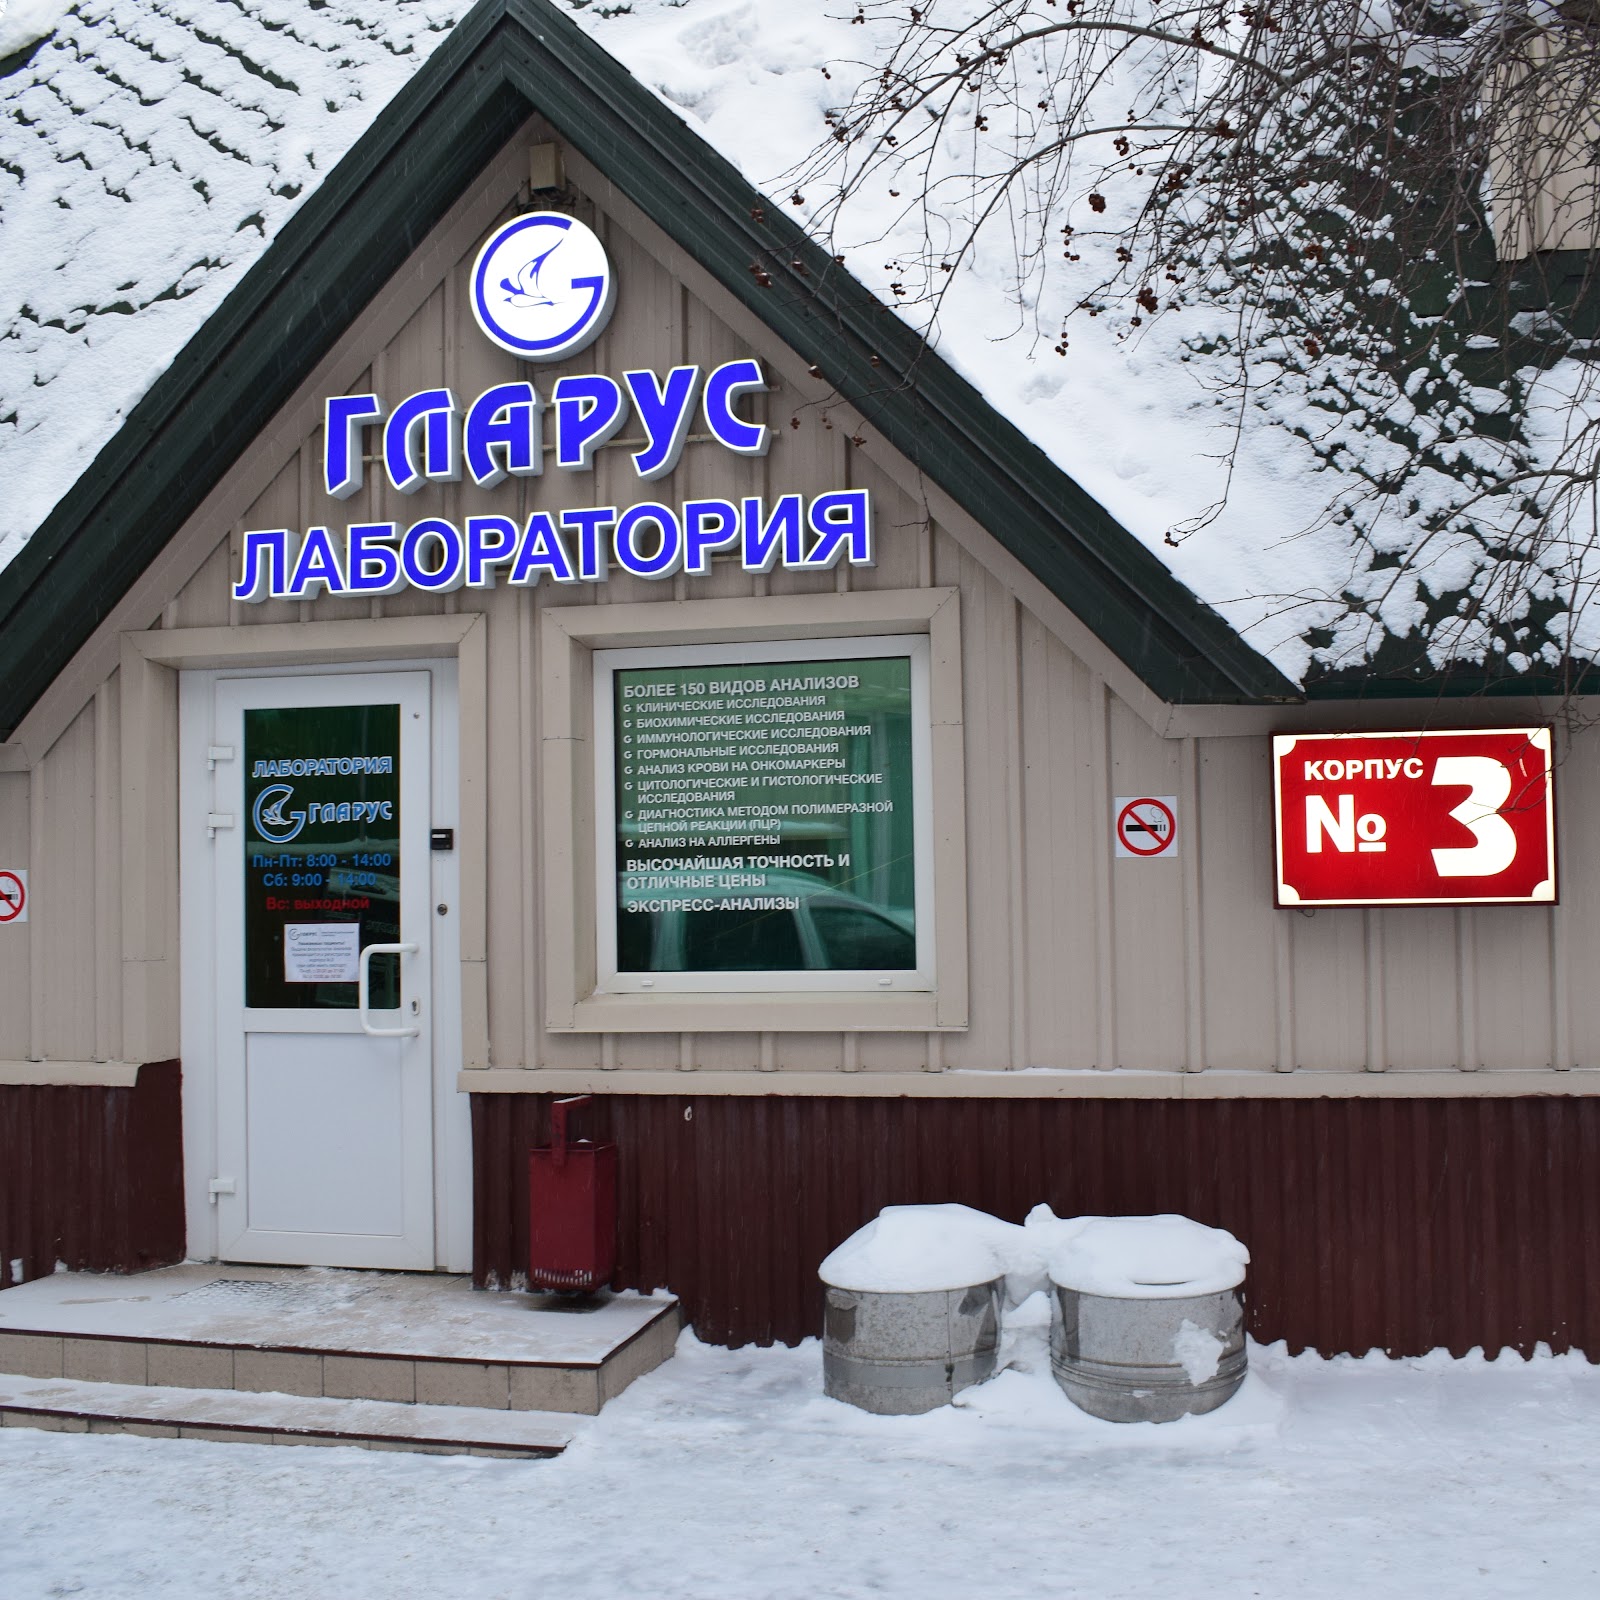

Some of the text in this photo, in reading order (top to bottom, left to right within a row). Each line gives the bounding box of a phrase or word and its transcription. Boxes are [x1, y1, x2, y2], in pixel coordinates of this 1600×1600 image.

[324, 358, 769, 497] ГЛАРУС
[232, 488, 870, 600] ЛАБОРАТОРИЯ
[624, 676, 859, 697] БОЛЕЕ 150 ВИДОВ АНАЛИЗОВ
[636, 699, 724, 713] КЛИНИЧЕСКИЕ
[726, 696, 826, 709] ИССЛЕДОВАНИЯ
[636, 715, 743, 728] БИОХИМИЧЕСКИЕ
[745, 711, 845, 724] ИССЛЕДОВАНИЯ
[637, 730, 769, 744] ИММУНОЛОГИЧЕСКИЕ
[771, 725, 871, 739] ИССЛЕДОВАНИЯ
[637, 746, 736, 759] ГОРМОНАЛЬНЫЕ
[740, 743, 839, 756] ИССЛЕДОВАНИЯ
[252, 756, 393, 778] ЛАБОРАТОРИЯ
[637, 764, 685, 775] АНАЛИЗ
[688, 762, 729, 773] КРОВИ
[732, 761, 748, 771] НА
[751, 759, 846, 771] ОНКОМАРКЕРЫ
[1304, 758, 1424, 781] КОРПУС
[638, 777, 748, 792] ЦИТОЛОГИЧЕСКИЕ
[751, 777, 759, 786] И
[762, 773, 883, 786] ГИСТОЛОГИЧЕСКИЕ
[638, 791, 735, 804] ИССЛЕДОВАНИЯ
[308, 801, 393, 824] ГЛАРУС
[638, 807, 725, 821] ДИАГНОСТИКА
[727, 805, 789, 817] МЕТОДОМ
[791, 800, 893, 814] ПОЛИМЕРАЗНОЙ
[1305, 755, 1517, 877] № 3
[638, 818, 781, 834] ЦЕПНОЙ РЕАКЦИИ (ПЦР)
[638, 838, 686, 849] АНАЛИЗ
[689, 837, 705, 847] НА
[708, 835, 780, 847] АЛЛЕРГЕНЫ
[252, 854, 302, 867] Пн-Пт:
[306, 854, 337, 867] 8:00
[352, 853, 391, 866] 14:00
[626, 854, 850, 872] ВЫСОЧАЙШАЯ ТОЧНОСТЬ И
[263, 873, 288, 886] Сб:
[291, 873, 322, 886] 9:00
[338, 872, 376, 886] 14:00
[627, 874, 766, 890] ОТЛИЧНЫЕ ЦЕНЫ
[266, 896, 370, 911] Вс: выходной
[627, 897, 799, 913] ЭКСПРЕСС-АНАЛИЗЫ
